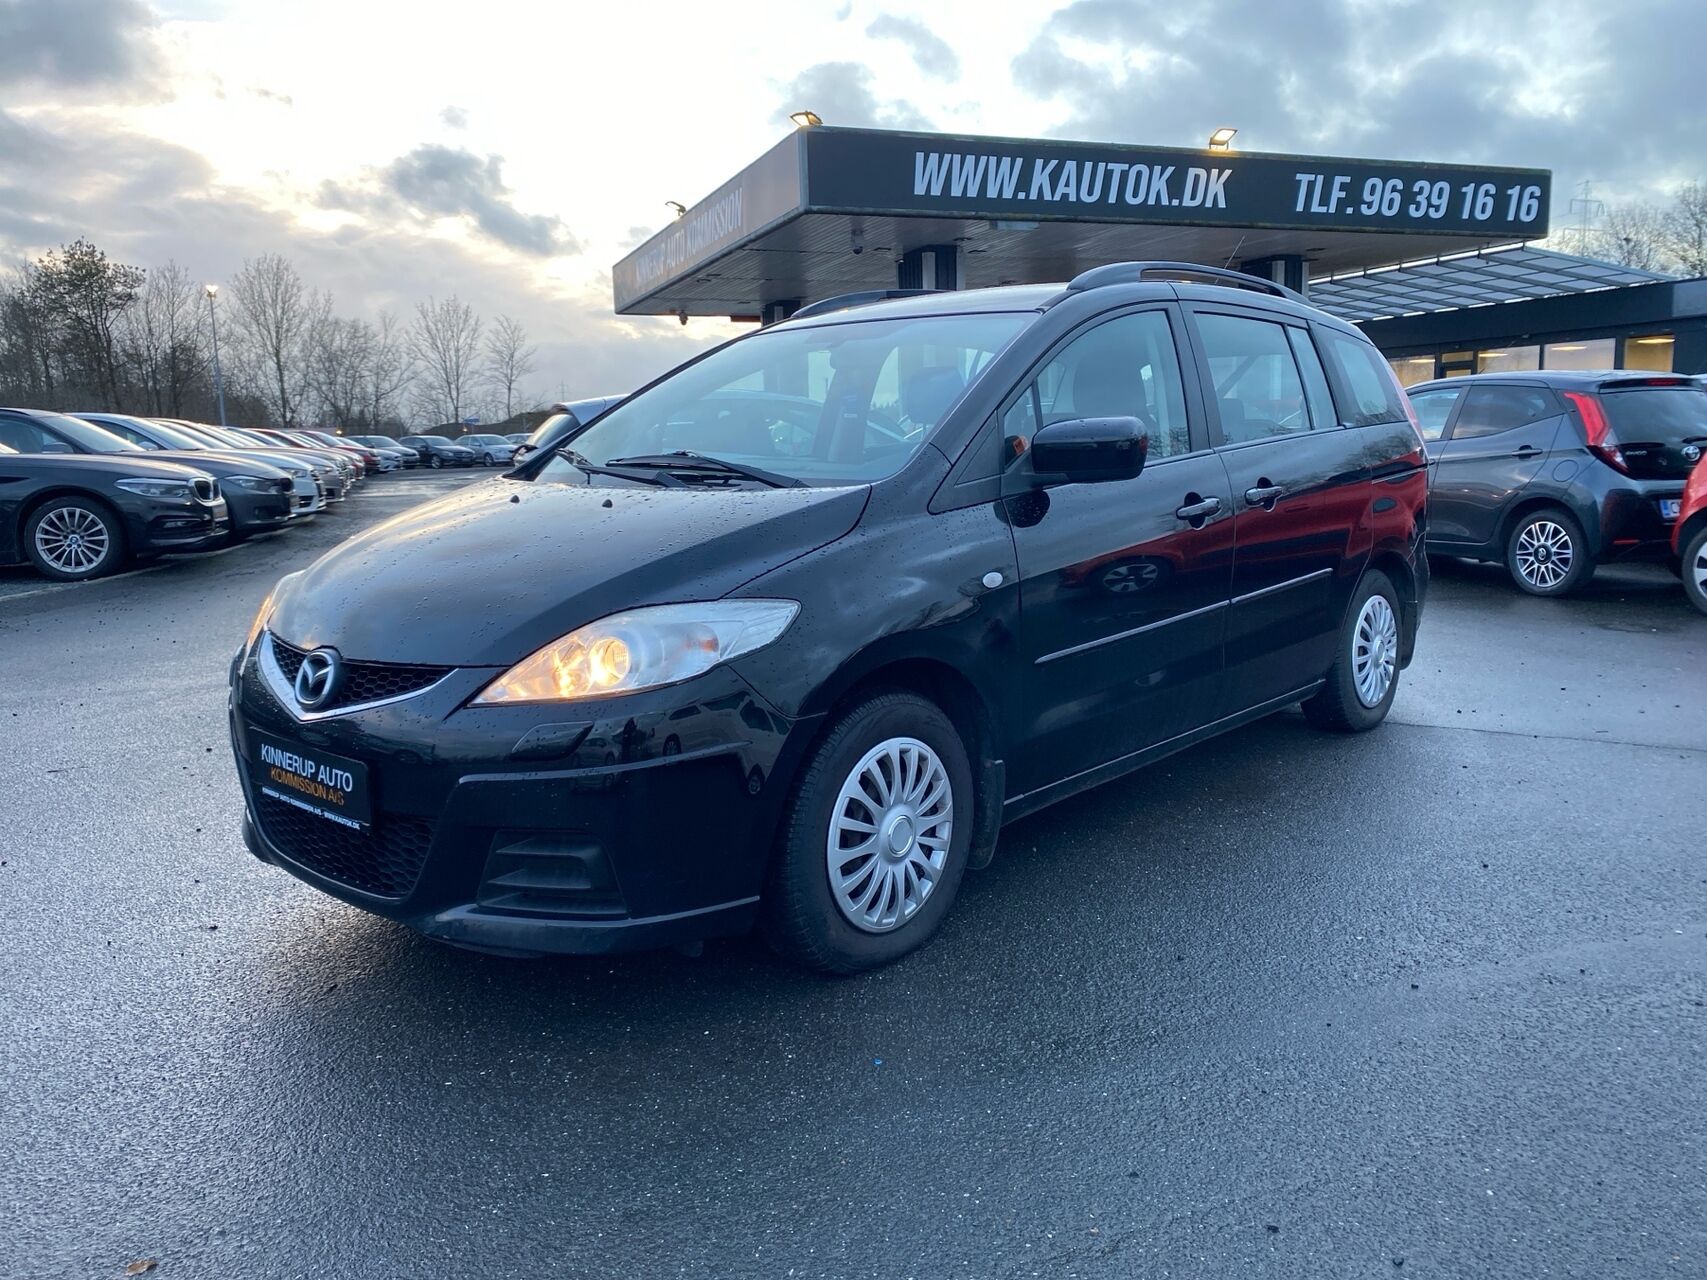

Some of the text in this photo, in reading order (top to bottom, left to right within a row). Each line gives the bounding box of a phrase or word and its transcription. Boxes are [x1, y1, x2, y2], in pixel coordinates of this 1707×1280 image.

[913, 151, 1233, 209] WWW.KAUTOK.DK
[1295, 173, 1542, 223] TLF. 96 39 16 16
[261, 743, 353, 792] KINNERUP AUTO
[270, 766, 327, 800] KOMMISSION
[328, 790, 345, 806] A/S
